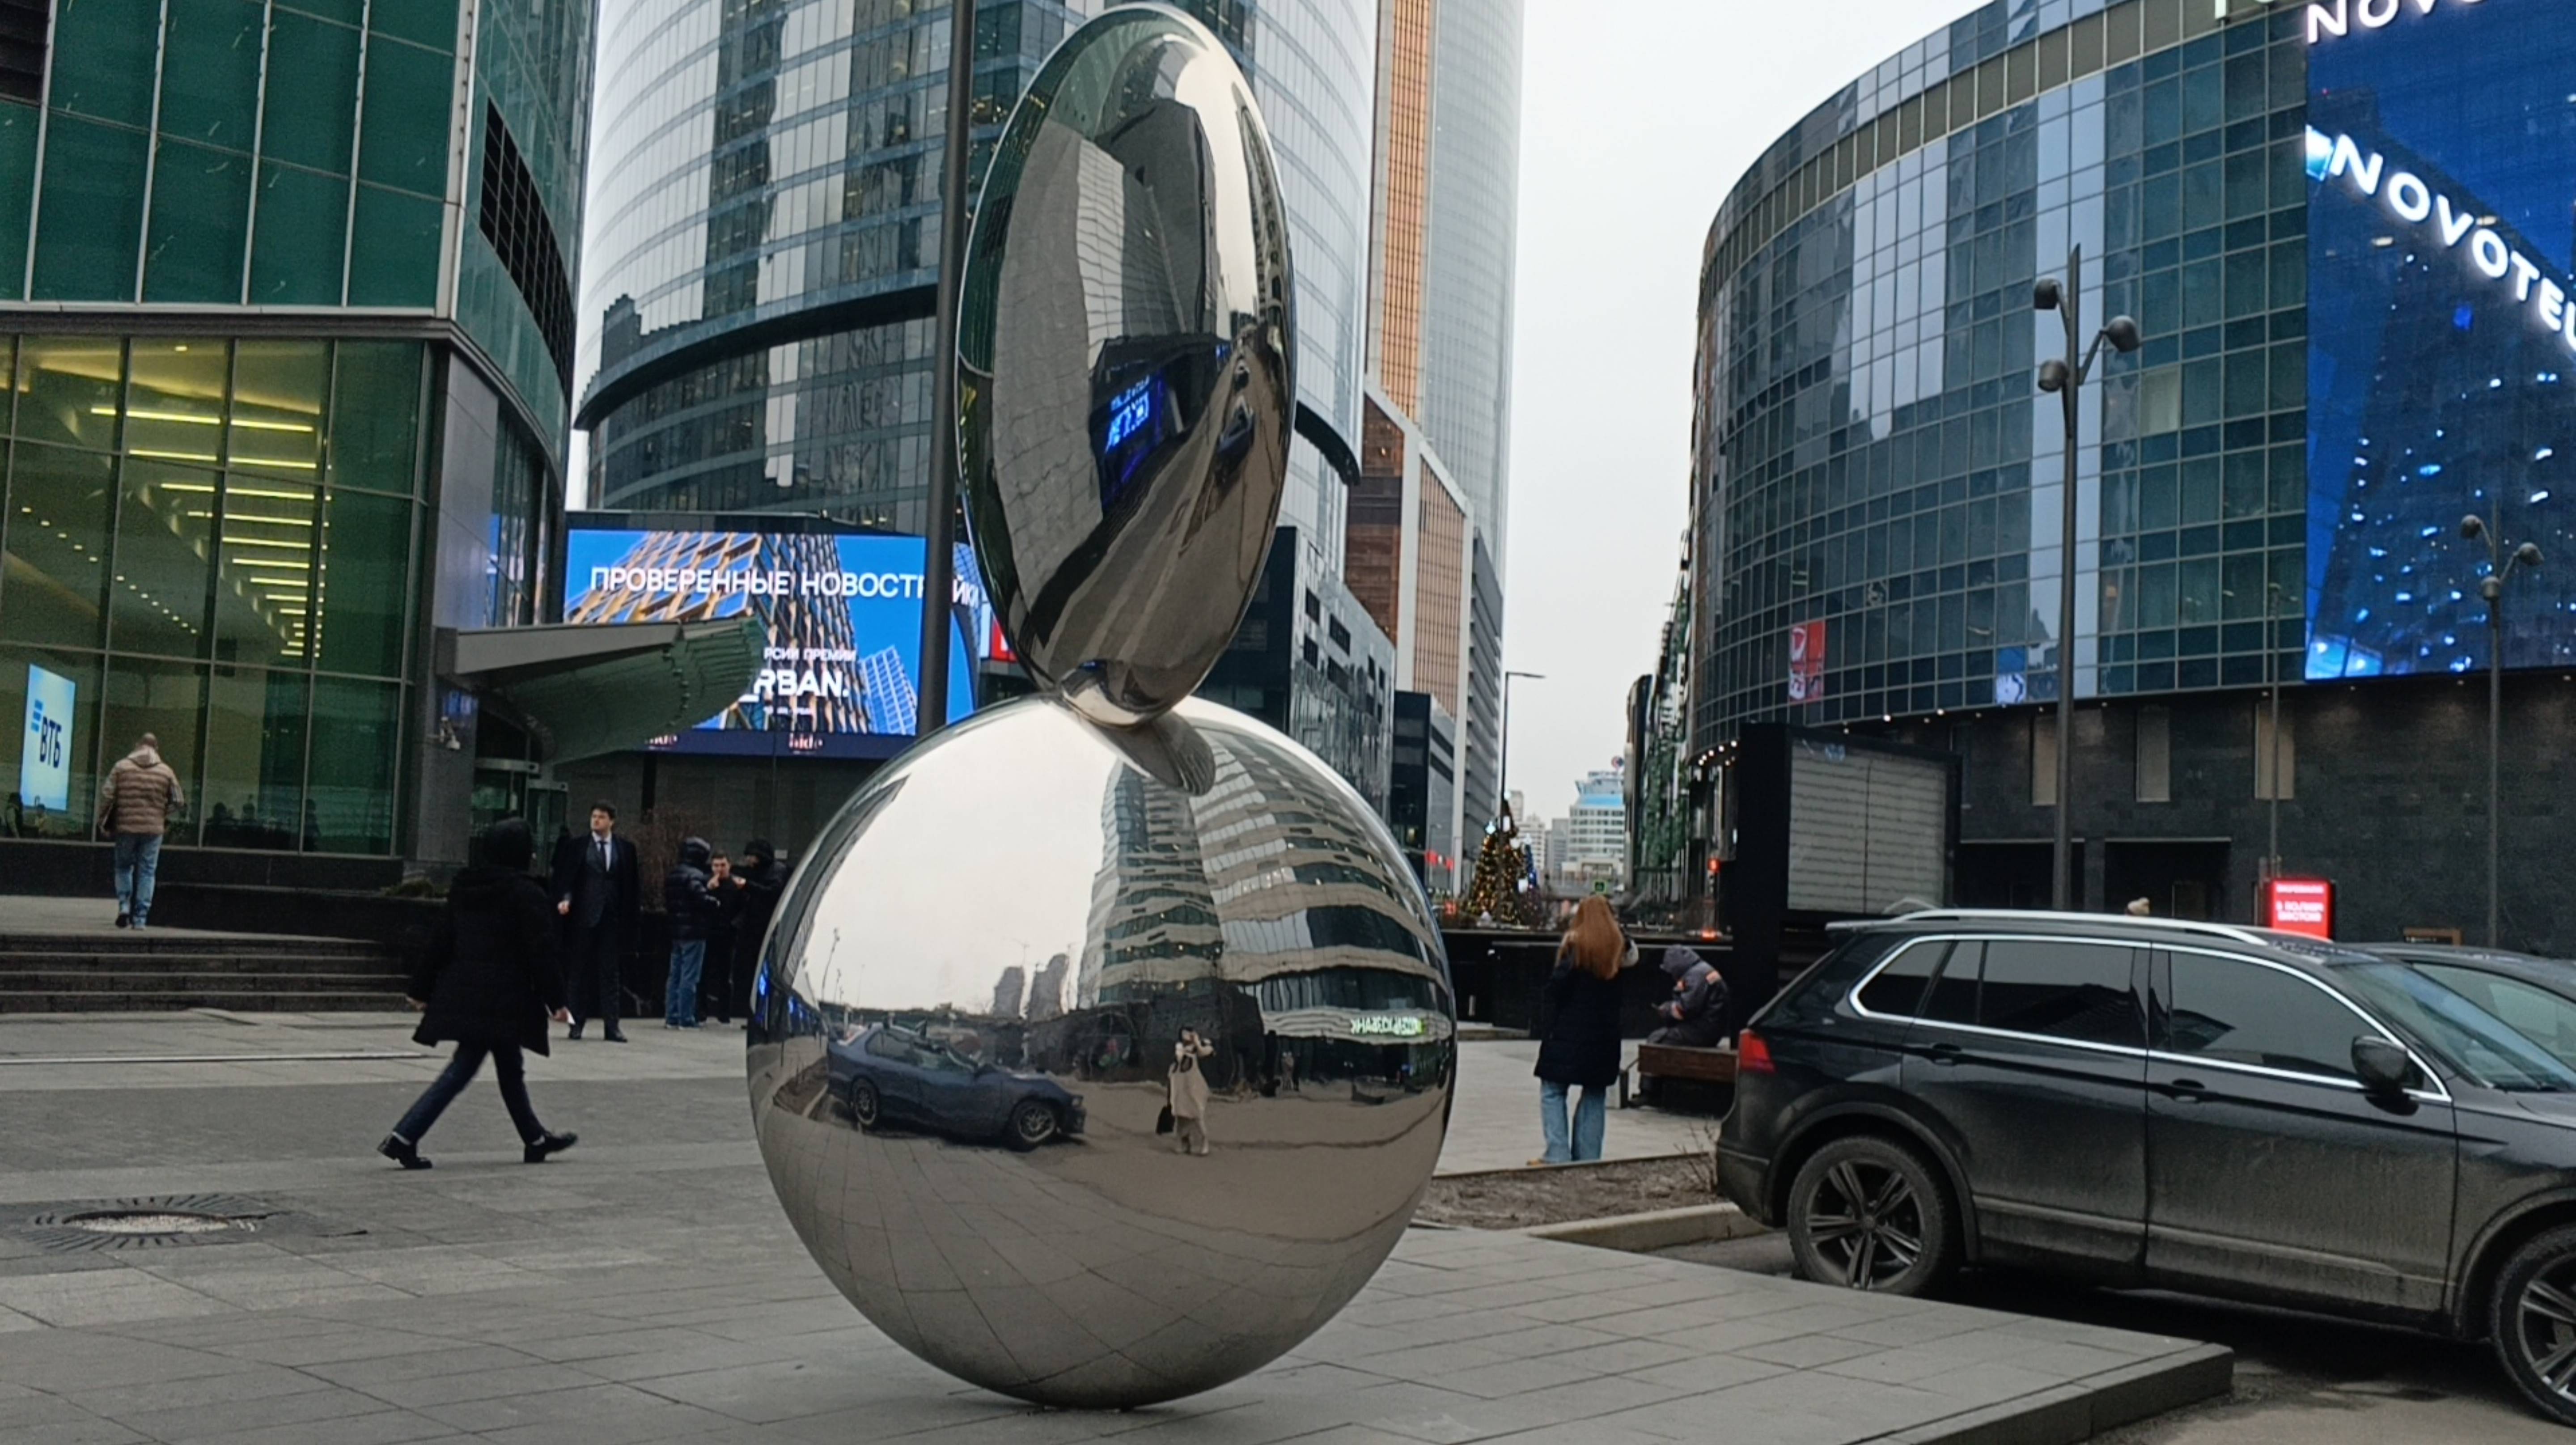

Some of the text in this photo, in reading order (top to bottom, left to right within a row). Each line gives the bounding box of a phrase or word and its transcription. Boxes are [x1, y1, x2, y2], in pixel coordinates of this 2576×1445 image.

[590, 566, 979, 609] ПРОВЕРЕННЫЕ НОВОСТЙКИ
[803, 648, 856, 661] ПРЕМИИ
[753, 669, 850, 697] RBAN.
[39, 716, 62, 769] ВТБ
